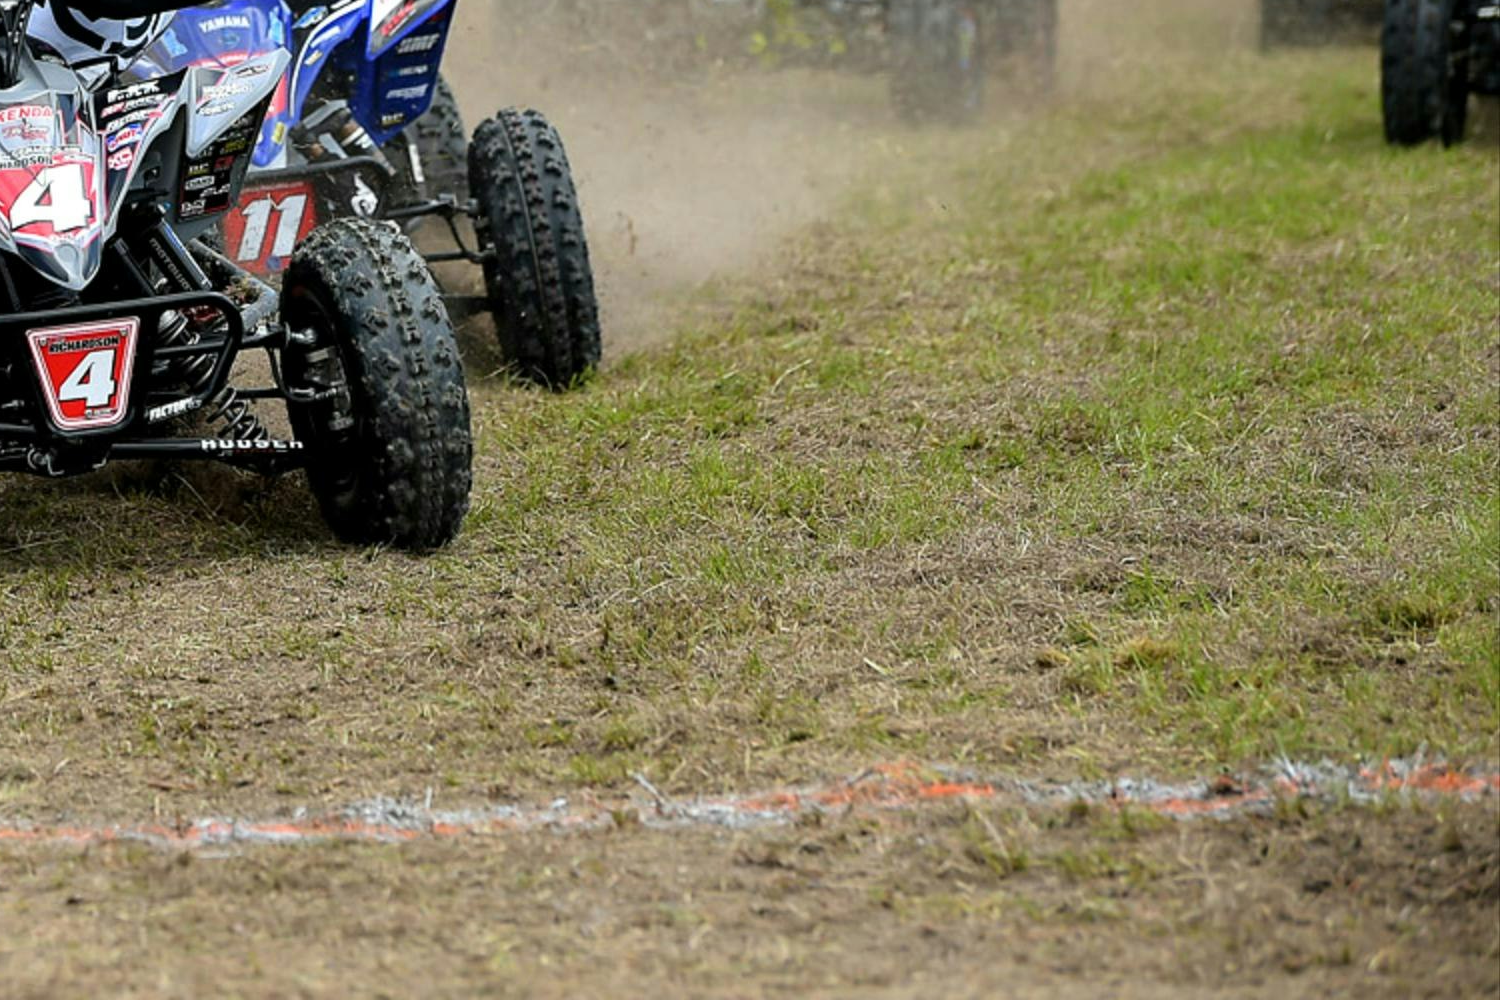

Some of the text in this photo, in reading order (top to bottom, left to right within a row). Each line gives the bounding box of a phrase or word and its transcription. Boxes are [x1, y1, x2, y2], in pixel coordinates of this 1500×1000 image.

[198, 15, 251, 33] YAMAHA
[9, 163, 93, 233] 4
[238, 193, 307, 262] 11
[49, 336, 119, 353] RICHARDSON
[58, 349, 115, 408] 4
